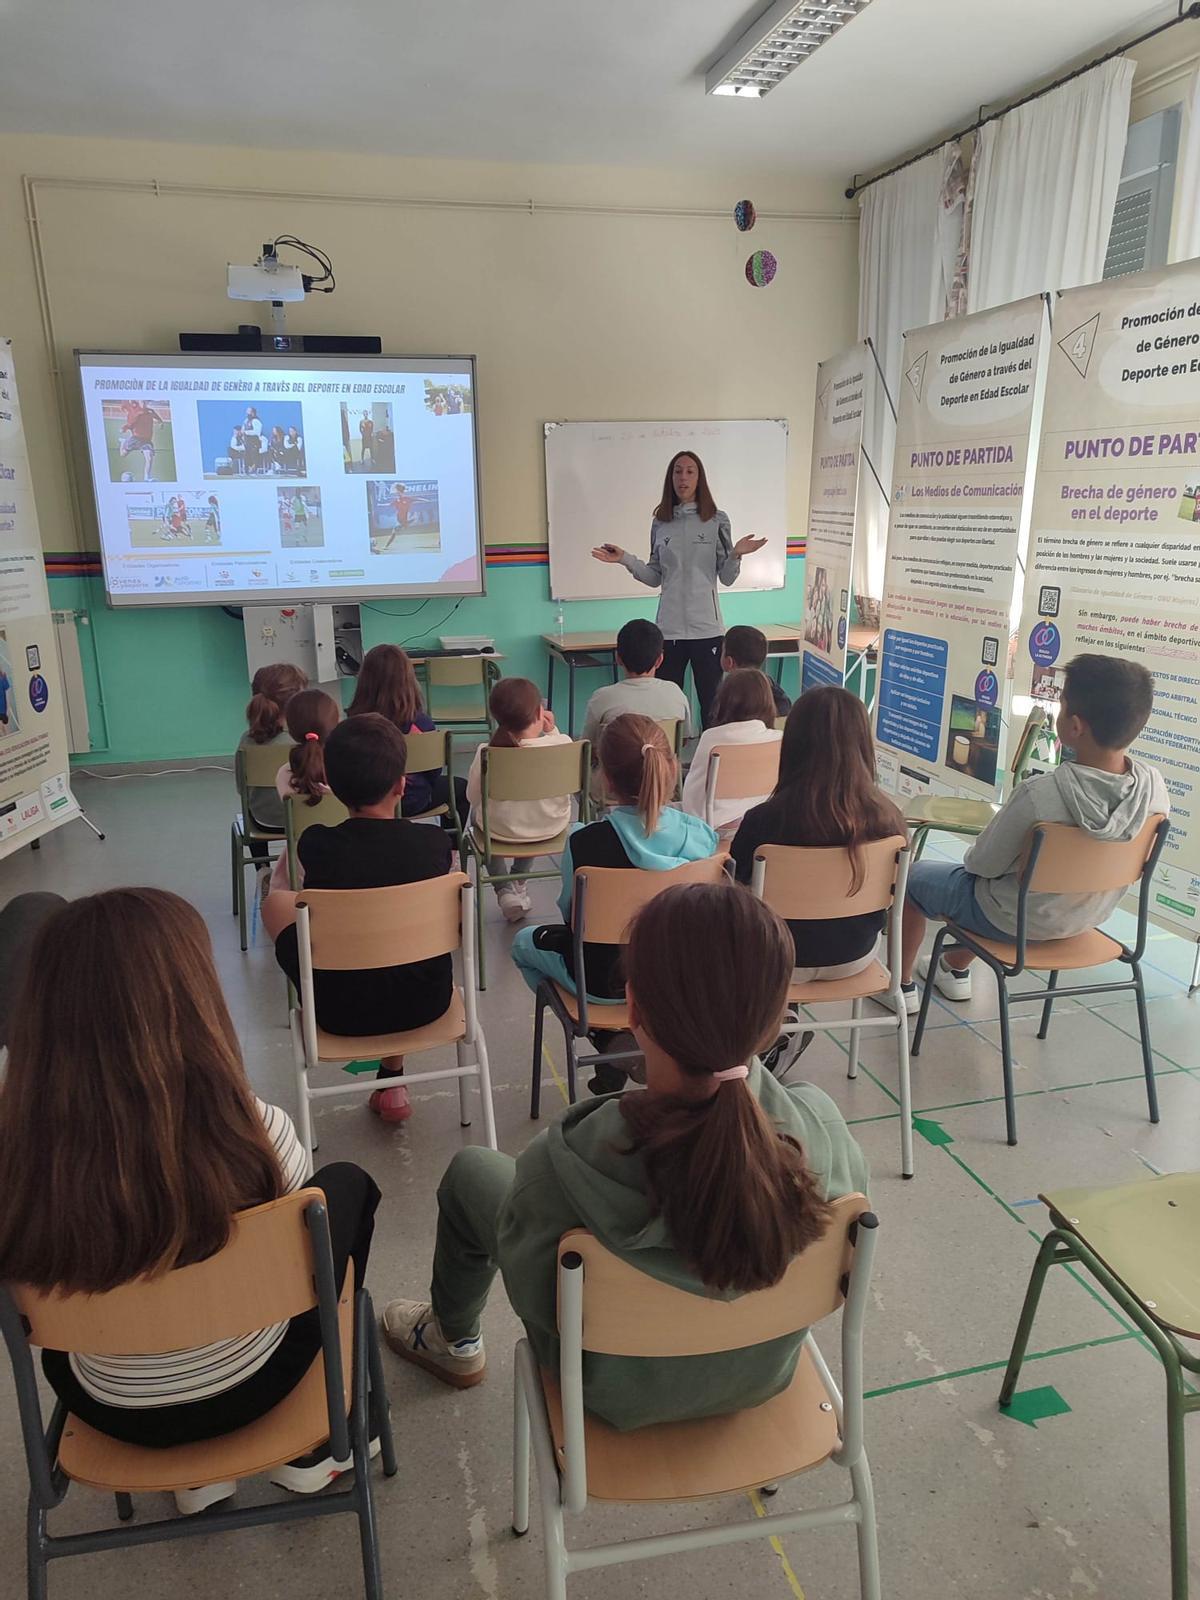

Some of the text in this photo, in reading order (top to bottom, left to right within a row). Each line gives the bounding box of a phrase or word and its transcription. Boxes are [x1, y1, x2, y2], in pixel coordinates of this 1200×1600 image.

[1121, 302, 1200, 330] Promoción de
[940, 333, 1035, 365] Promoción de la Igualdad
[1136, 334, 1200, 353] de Género
[949, 357, 1032, 384] de Género a través del
[1121, 365, 1169, 383] Deporte
[1171, 364, 1187, 375] en
[146, 380, 156, 391] DE
[158, 380, 168, 391] LA
[170, 381, 210, 391] IGUALDAD
[211, 381, 222, 391] DE
[254, 382, 260, 392] A
[292, 382, 305, 392] DEL
[307, 383, 340, 393] DEPORTE
[341, 383, 351, 393] EN
[352, 383, 372, 393] EDAD
[373, 384, 406, 394] ESCOLAR
[940, 383, 1030, 408] Deporte en Edad Escolar
[1064, 437, 1125, 459] PUNTO
[1128, 435, 1155, 456] DE
[911, 445, 1013, 468] PUNTO DE PARTIDA
[911, 483, 1023, 497] Los Medios de Comunicación
[1061, 484, 1177, 503] Brecha de género
[1071, 505, 1158, 524] en el deporte
[1086, 538, 1103, 547] género
[1135, 541, 1160, 549] cualquier
[1161, 543, 1191, 551] disparidad
[1077, 566, 1096, 575] ingresos
[1078, 609, 1198, 631] Sin embargo, puede haber brecha de
[1075, 635, 1096, 645] reflejar
[1097, 638, 1104, 646] en
[1105, 639, 1114, 648] los
[1115, 641, 1146, 653] siguientes
[1143, 631, 1167, 642] ámbito
[1152, 671, 1170, 680] ESTOS
[1152, 690, 1198, 704] QUIPO ARBITRAL
[1152, 708, 1198, 723] RSONAL TÉCNICO
[1143, 726, 1173, 738] TICIPACIÓN
[1162, 757, 1200, 773] PUBLICITARIO
[1166, 785, 1185, 798] ACIÓN
[1172, 779, 1193, 791] MEDIOS
[1169, 804, 1191, 818] ÓMICOS
[1168, 833, 1176, 841] EL
[1165, 841, 1180, 850] TIVO
